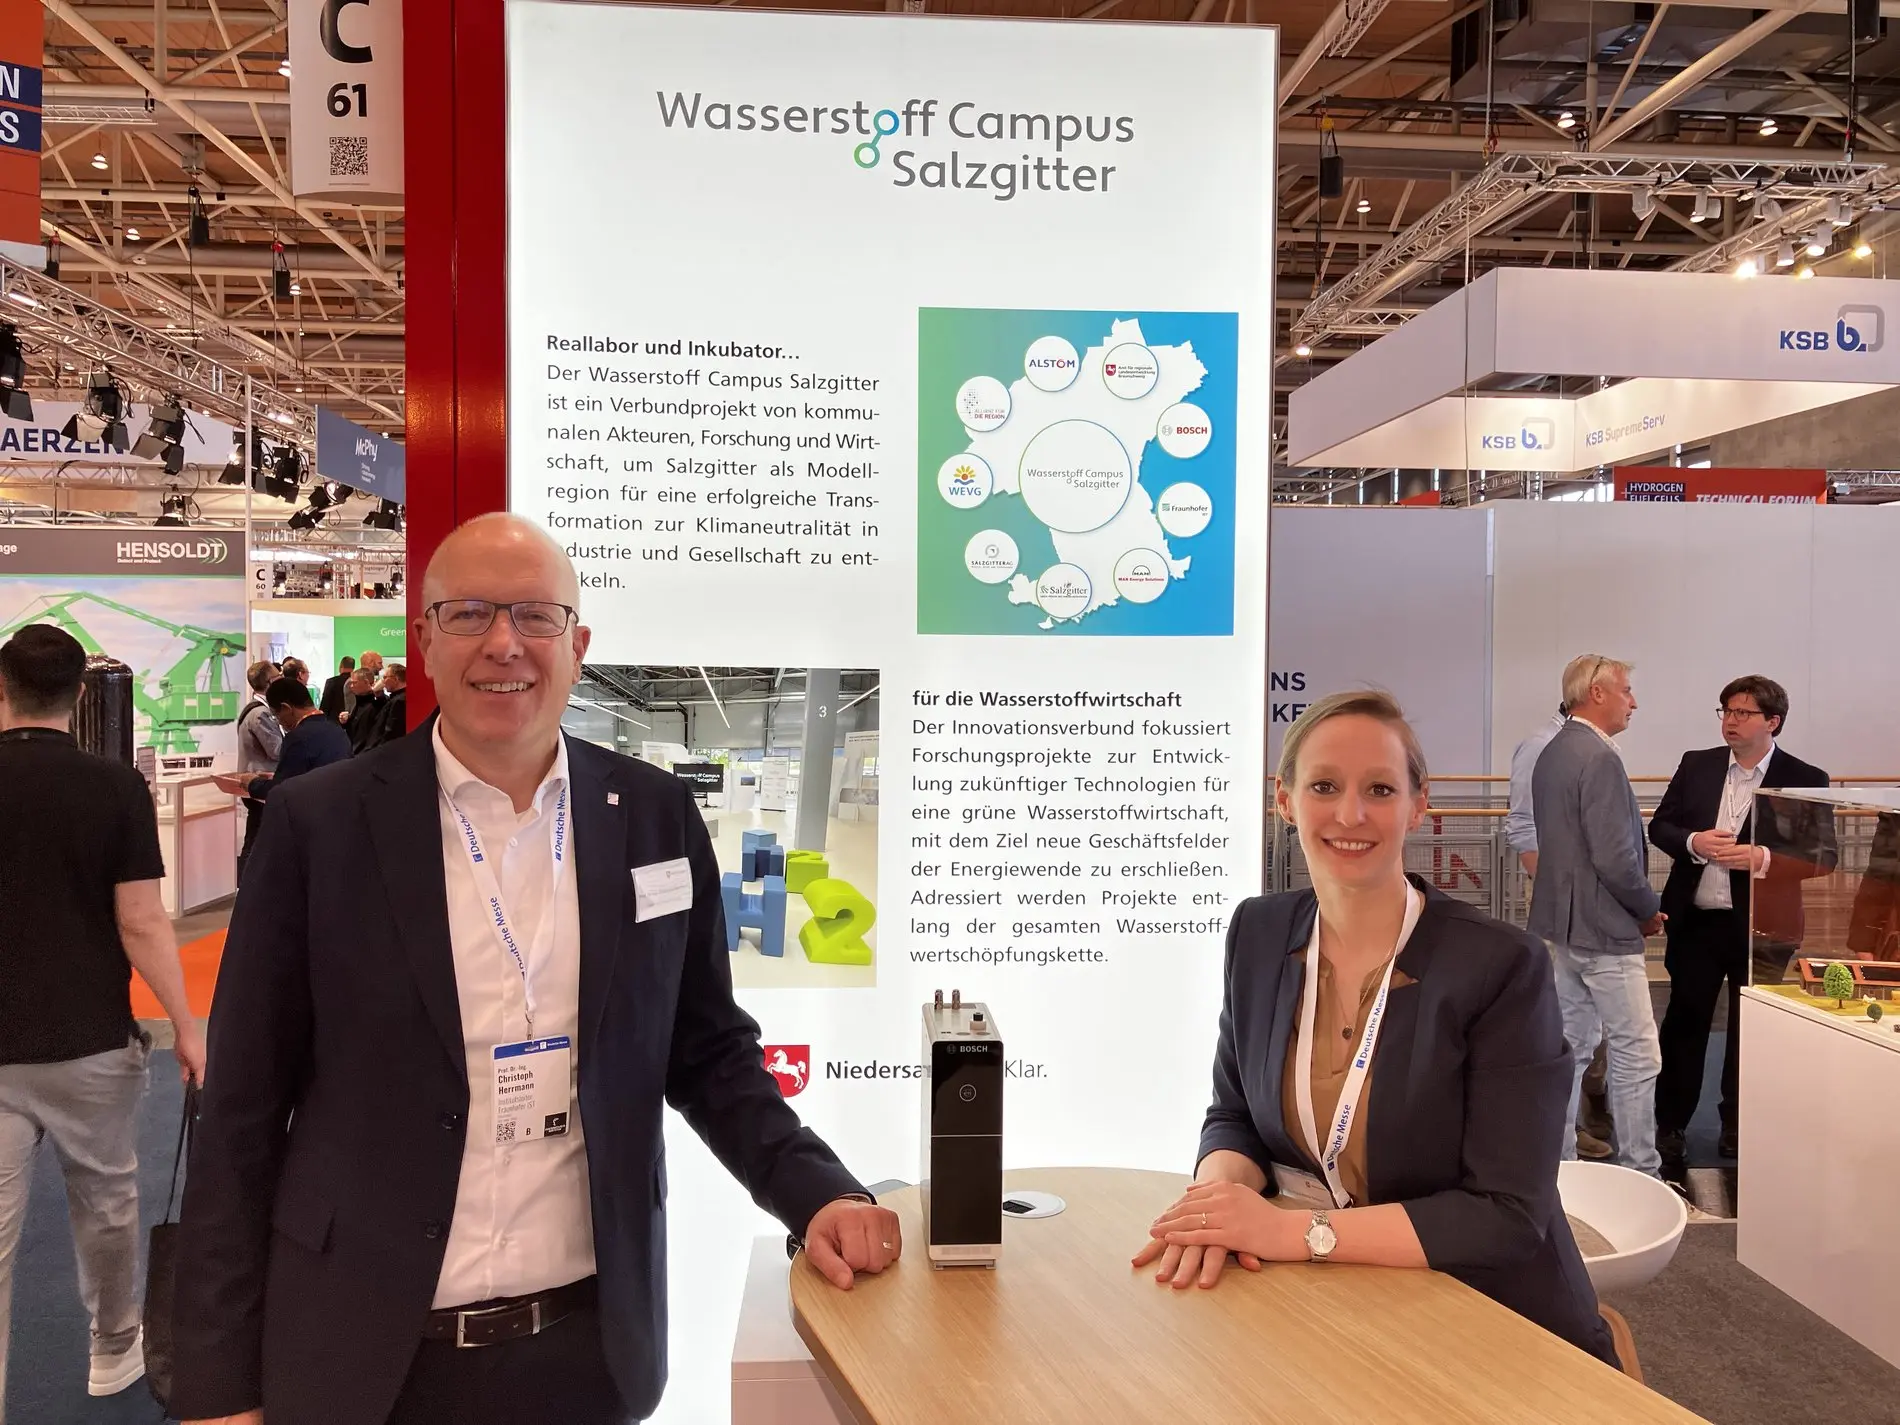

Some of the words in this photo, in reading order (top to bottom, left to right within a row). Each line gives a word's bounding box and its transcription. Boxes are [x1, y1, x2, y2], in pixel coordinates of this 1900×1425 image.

[320, 0, 373, 63] C
[327, 82, 368, 117] 61
[657, 92, 938, 138] Wasserstoff
[949, 102, 1133, 151] Campus
[893, 151, 1116, 201] Salzgitter
[548, 335, 638, 353] Reallabor
[646, 340, 681, 355] und
[689, 341, 799, 359] Inkubator...
[1780, 330, 1829, 350] KSB
[1029, 359, 1075, 368] ALSTOM
[548, 365, 581, 380] Der
[589, 367, 700, 385] Wasserstoff
[709, 371, 782, 391] Campus
[791, 373, 879, 394] Salzgitter
[548, 394, 567, 410] ist
[575, 396, 602, 411] ein
[610, 397, 756, 420] Verbundprojekt
[764, 406, 796, 418] von
[805, 403, 879, 420] kommu-
[548, 424, 599, 440] nalen
[607, 426, 694, 447] Akteuren,
[702, 430, 790, 451] Forschung
[797, 433, 830, 448] und
[836, 434, 880, 449] Wirt-
[1176, 426, 1208, 435] BOSCH
[1586, 430, 1604, 447] KSB
[355, 438, 378, 462] McPhy
[1482, 436, 1516, 449] KSB
[547, 453, 608, 473] schaft,
[624, 461, 652, 472] um
[667, 458, 757, 478] Salzgitter
[770, 461, 794, 476] als
[808, 462, 879, 478] Modell-
[1027, 469, 1083, 478] Wasserstoff
[1085, 470, 1124, 480] Campus
[949, 486, 982, 496] WEVG
[1074, 479, 1120, 490] Salzgitter
[1629, 483, 1684, 492] HYDROGEN
[548, 484, 608, 503] region
[620, 485, 647, 501] für
[658, 487, 696, 503] eine
[707, 488, 816, 509] erfolgreiche
[826, 492, 879, 507] Trans-
[547, 512, 642, 530] formation
[655, 520, 684, 531] zur
[697, 517, 851, 536] Klimaneutralität
[863, 521, 878, 536] in
[117, 542, 223, 558] HENSOLDT
[565, 542, 631, 559] dustrie
[643, 545, 677, 560] und
[689, 547, 801, 564] Gesellschaft
[811, 553, 831, 564] zu
[842, 552, 879, 565] ent-
[256, 568, 266, 581] C
[581, 572, 625, 588] keln.
[1050, 585, 1088, 596] Salzgitter
[380, 627, 406, 637] Green
[1271, 672, 1306, 692] NS
[913, 690, 940, 705] für
[946, 691, 973, 706] die
[979, 691, 1182, 707] Wasserstoffwirtschaft
[819, 705, 827, 718] 3
[913, 720, 944, 734] Der
[953, 720, 1133, 735] Innovationsverbund
[1142, 720, 1230, 735] fokussiert
[913, 747, 1091, 767] Forschungsprojekte
[1108, 753, 1136, 763] zur
[1153, 748, 1230, 763] Entwick-
[913, 776, 952, 795] lung
[960, 776, 1067, 795] zukünftiger
[1074, 777, 1195, 796] Technologien
[1204, 776, 1230, 791] für
[912, 804, 950, 819] eine
[963, 805, 1015, 823] grüne
[1028, 805, 1228, 822] Wasserstoffwirtschaft,
[555, 812, 566, 852] Deutsche
[912, 833, 941, 847] mit
[949, 833, 988, 848] dem
[996, 833, 1027, 848] Ziel
[1037, 837, 1080, 848] neue
[1089, 833, 1229, 848] Geschäftsfelder
[911, 861, 941, 876] der
[952, 861, 1081, 880] Energiewende
[1091, 866, 1111, 876] zu
[1121, 861, 1227, 876] erschließen.
[911, 890, 1002, 905] Adressiert
[1017, 890, 1085, 905] werden
[1103, 890, 1176, 909] Projekte
[1193, 892, 1228, 905] ent-
[490, 896, 506, 927] Messe
[912, 918, 949, 937] lang
[967, 918, 996, 933] der
[1013, 920, 1099, 937] gesamten
[1117, 918, 1227, 933] Wasserstoff-
[910, 947, 1108, 966] wertschöpfungskette.
[1360, 1017, 1378, 1059] Deutsche
[959, 1045, 988, 1053] BOSCH
[498, 1070, 534, 1084] Christoph
[826, 1060, 922, 1078] Niedersa
[1005, 1059, 1048, 1078] Klar.
[498, 1082, 535, 1095] Herrmann
[1337, 1104, 1351, 1134] Messe
[525, 1127, 531, 1136] B
